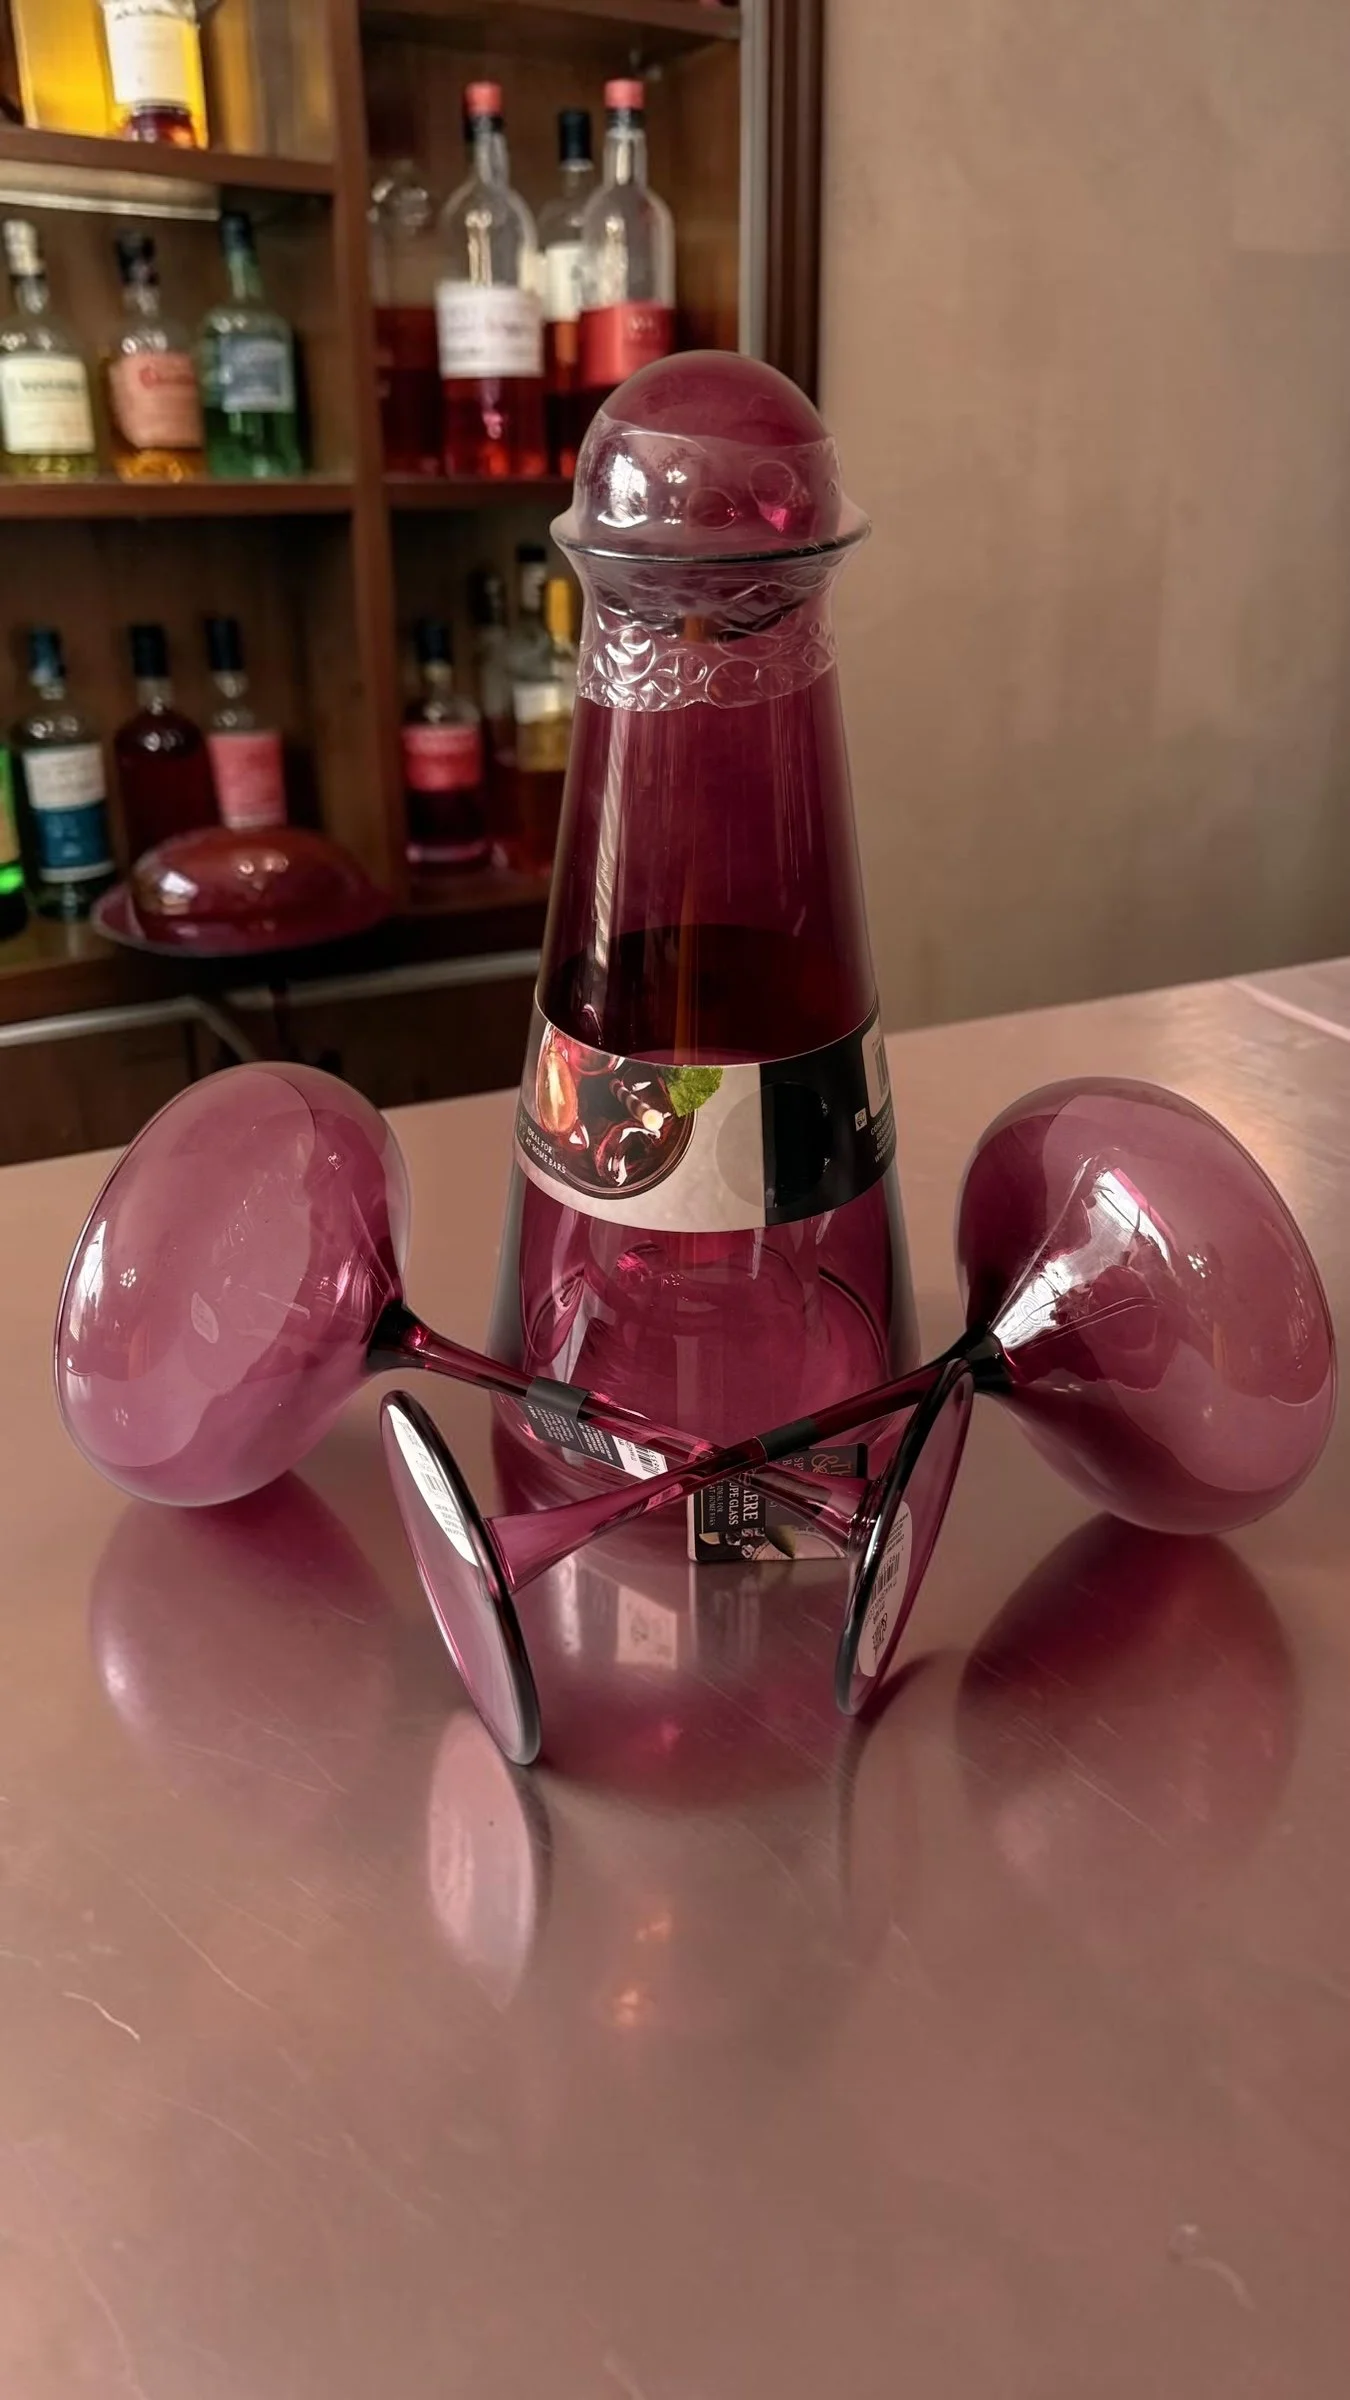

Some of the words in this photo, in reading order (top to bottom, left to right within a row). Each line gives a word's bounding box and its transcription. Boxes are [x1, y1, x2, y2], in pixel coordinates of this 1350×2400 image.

[527, 1126, 540, 1145] IDEAL
[540, 1140, 552, 1154] FOR
[549, 1158, 566, 1173] BARS
[728, 1499, 739, 1526] GLASS
